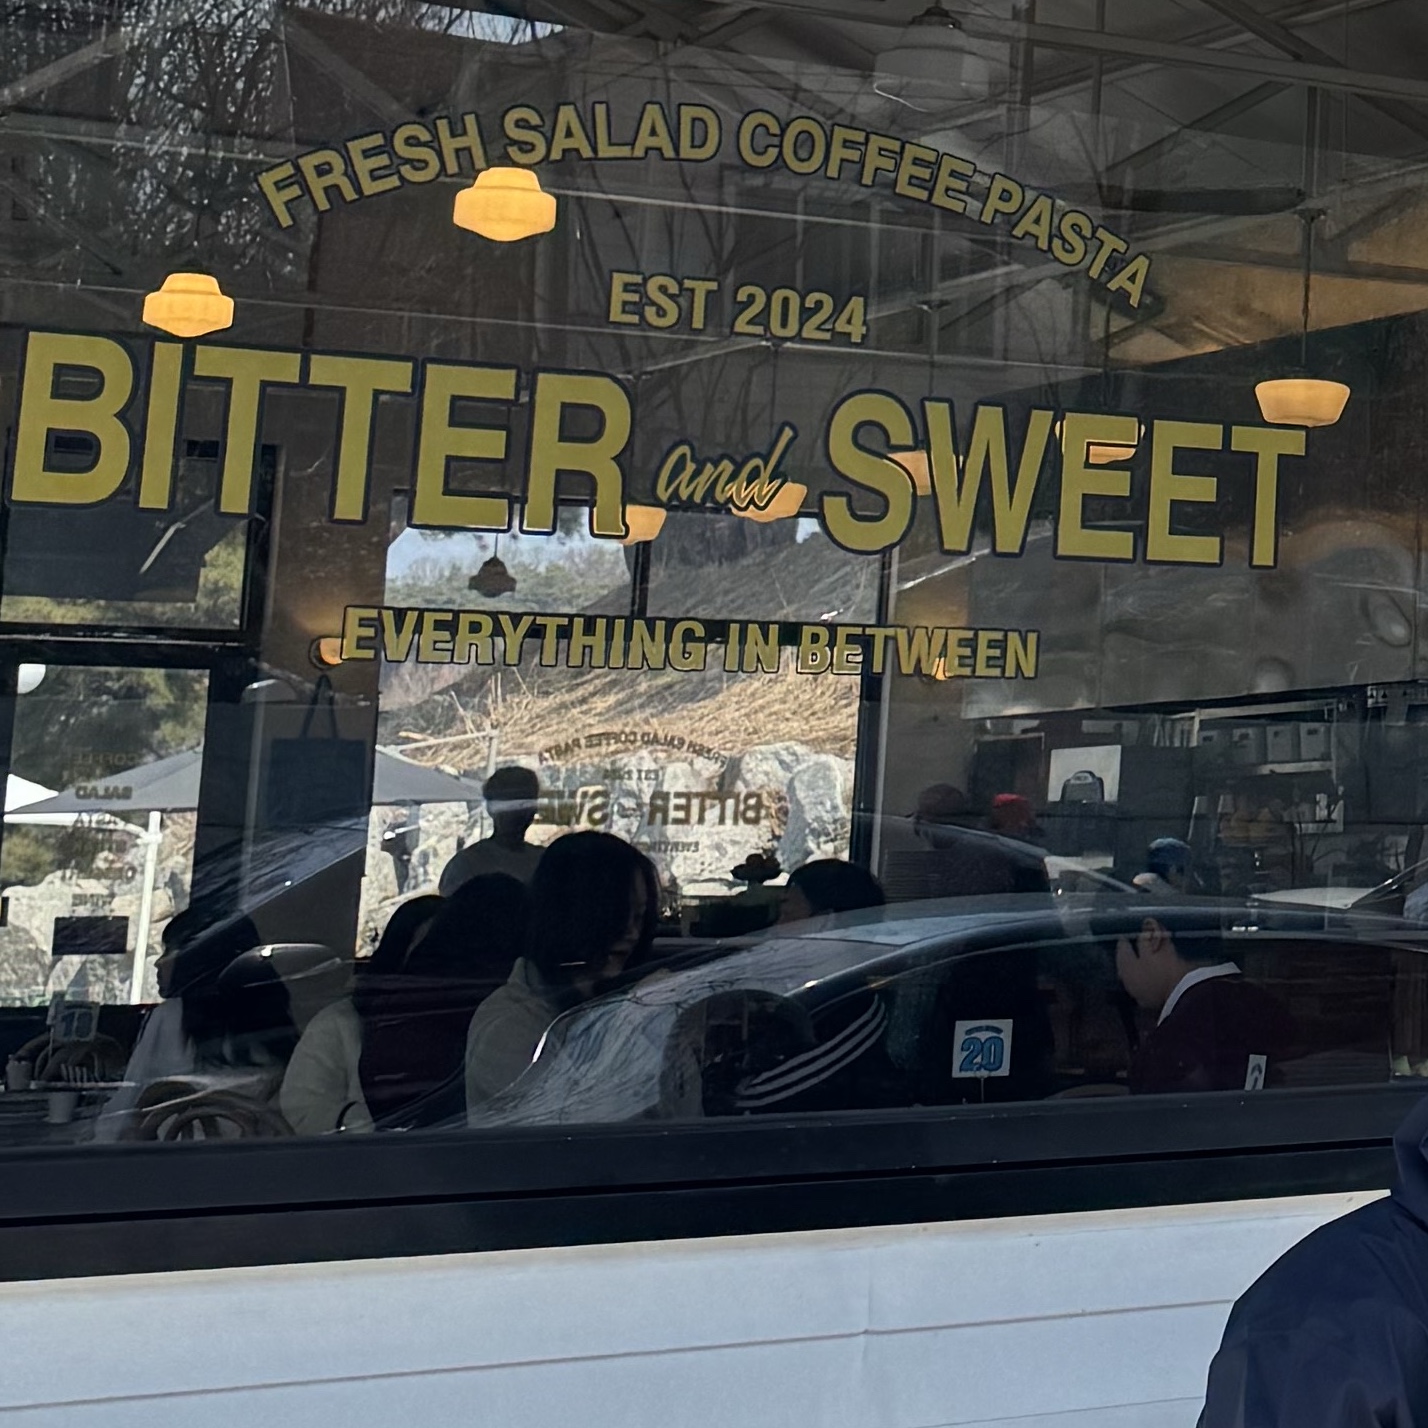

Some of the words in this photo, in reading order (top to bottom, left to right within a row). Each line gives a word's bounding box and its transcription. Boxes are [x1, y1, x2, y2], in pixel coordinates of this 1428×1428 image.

[257, 112, 487, 229] FRESH
[503, 102, 722, 162] SALAD
[738, 111, 977, 214] COFFEE
[980, 171, 1152, 309] PASTA
[608, 271, 718, 331] EST
[733, 283, 868, 344] 2024
[7, 329, 635, 538] BITTER
[653, 420, 799, 512] and
[818, 386, 1308, 569] SWEET
[341, 604, 708, 673] EVERYTHING
[723, 619, 782, 675] IN
[797, 622, 1040, 681] BETWEEN
[959, 1036, 1004, 1073] 20
